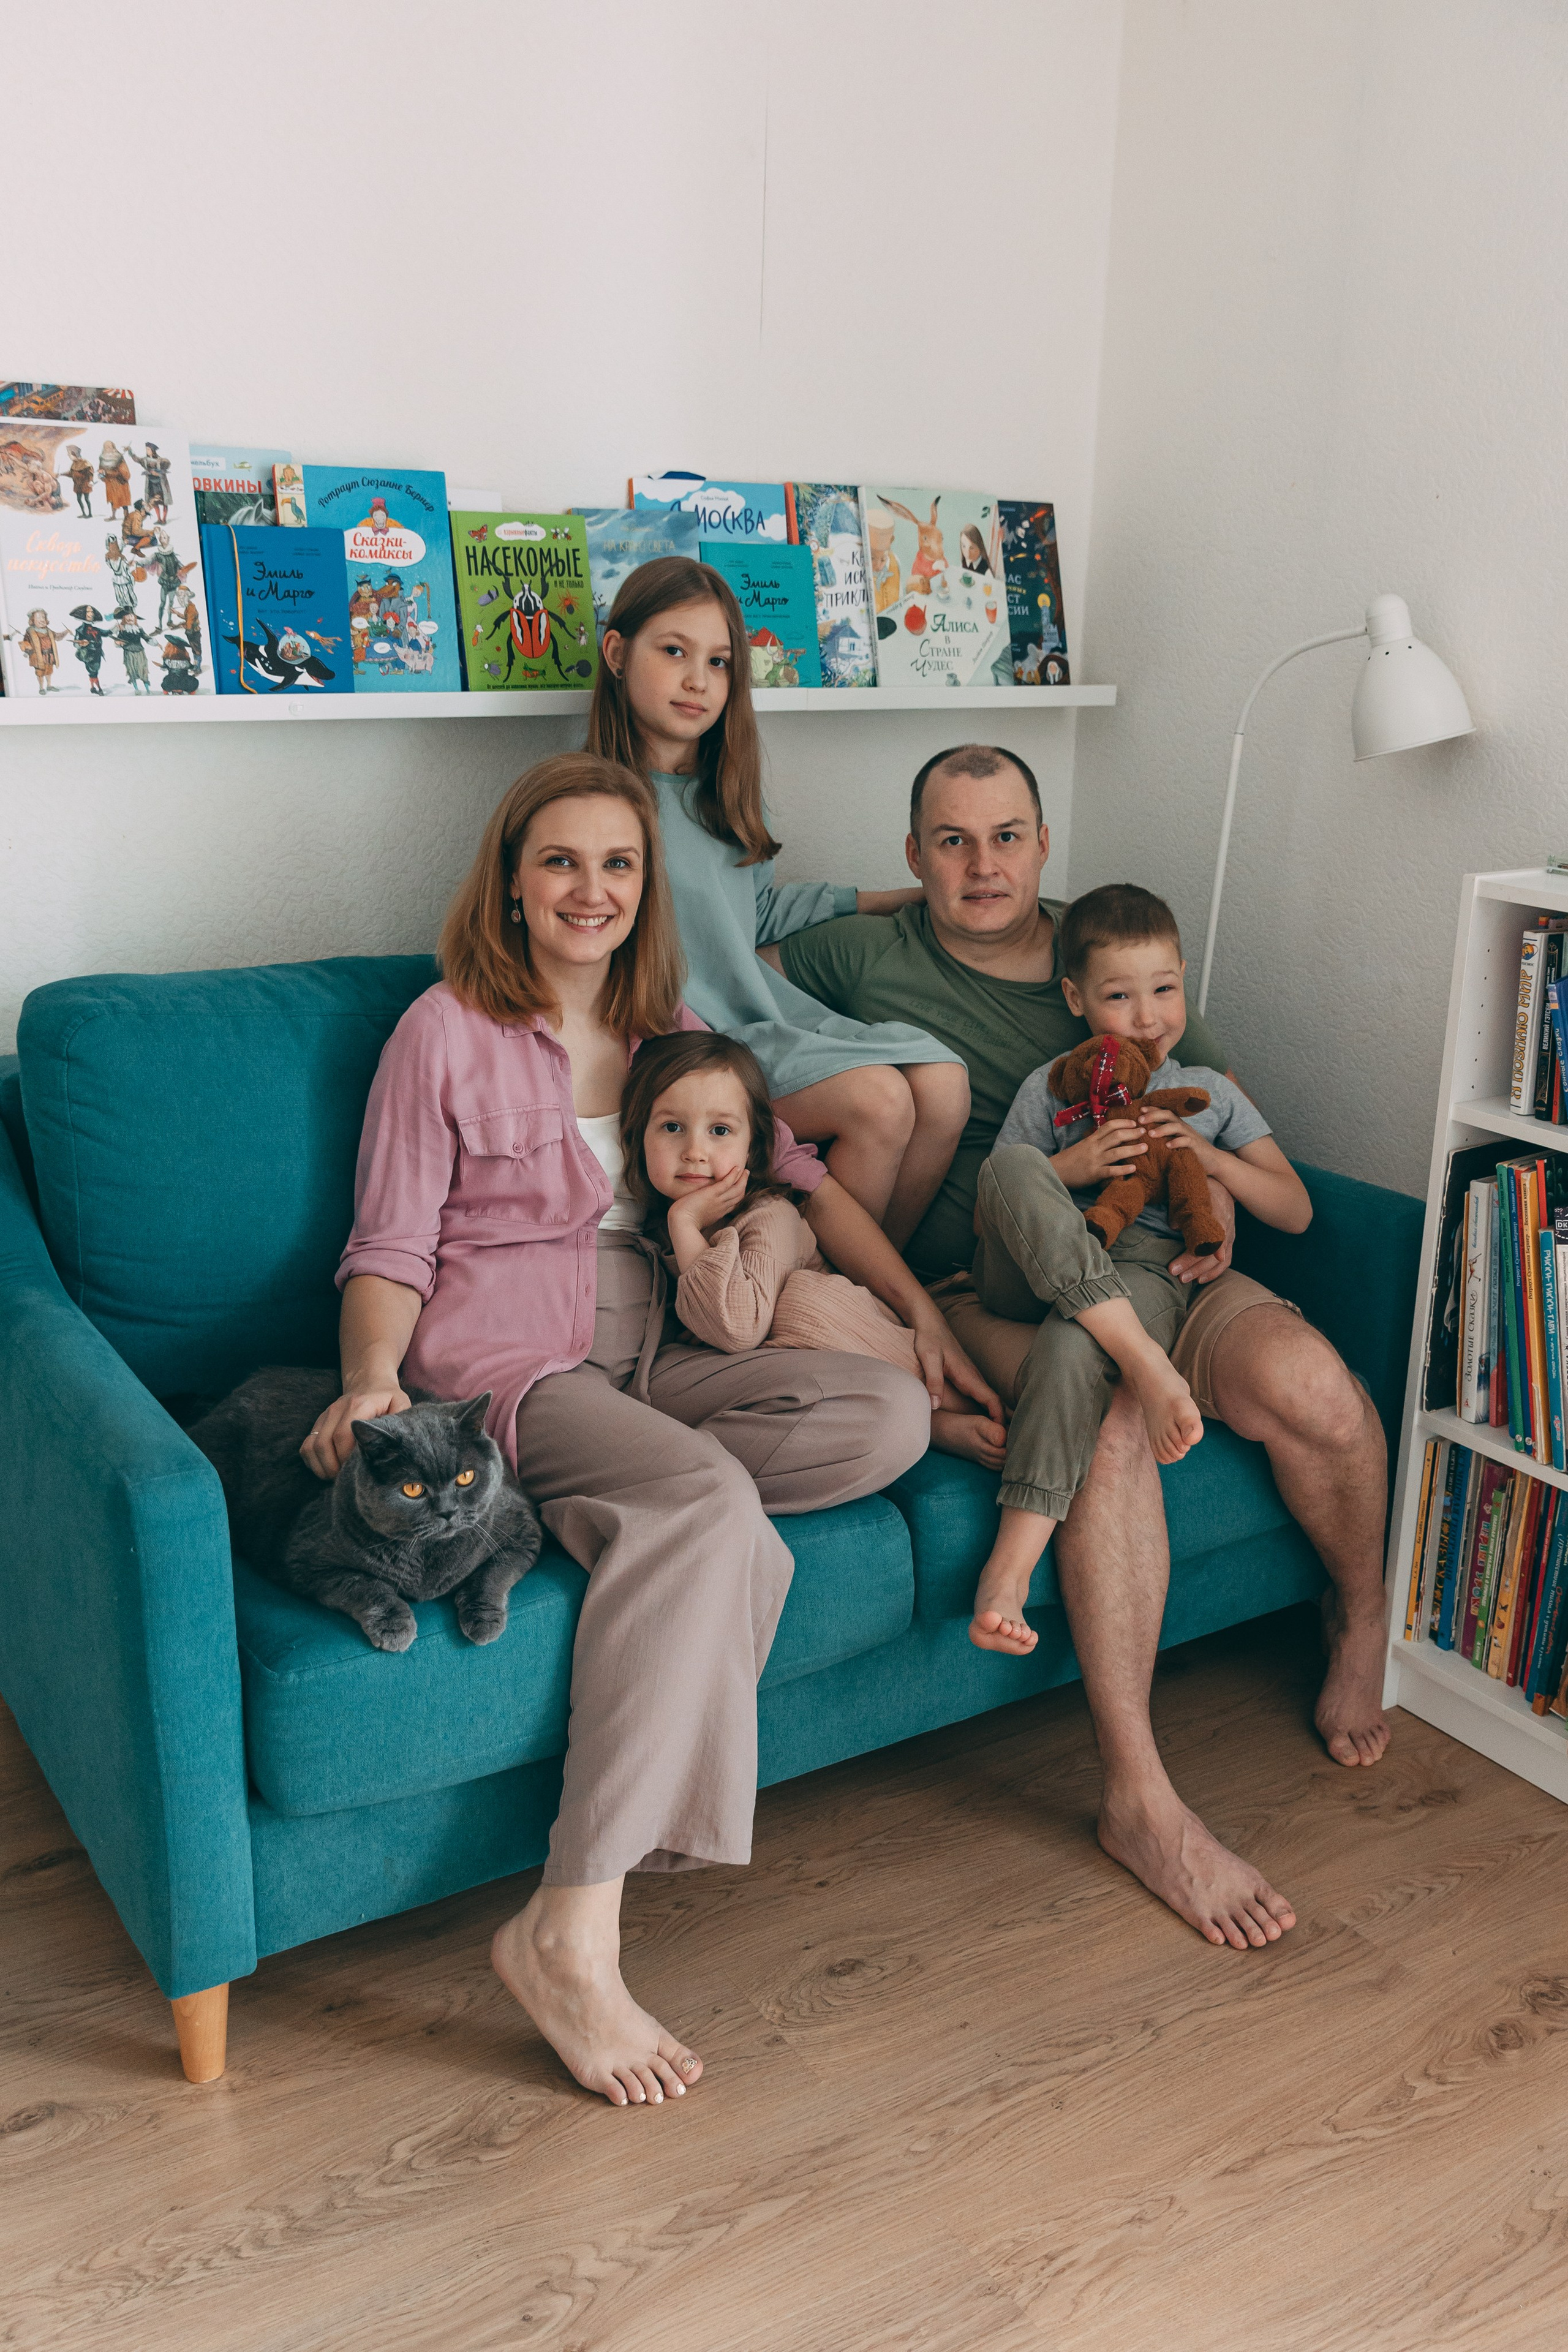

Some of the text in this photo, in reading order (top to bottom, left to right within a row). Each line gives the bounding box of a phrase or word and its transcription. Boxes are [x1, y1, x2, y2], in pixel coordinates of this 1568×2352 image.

[192, 477, 262, 494] ОВКИНЫ
[318, 477, 435, 513] Ротраут Сюзанне Бернер
[694, 504, 766, 535] МОСКВА
[26, 529, 83, 559] Сквозь
[350, 548, 413, 560] комиксы
[353, 532, 407, 551] Сказки-
[7, 554, 102, 581] искусство
[252, 561, 304, 581] Эмиль
[465, 545, 584, 578] НАСЕКОМЫЕ
[246, 580, 315, 606] и Марго
[740, 573, 780, 590] Эмиль
[745, 589, 789, 612] Марго
[1510, 969, 1532, 1100] Я ПОЗНАЮ МИР
